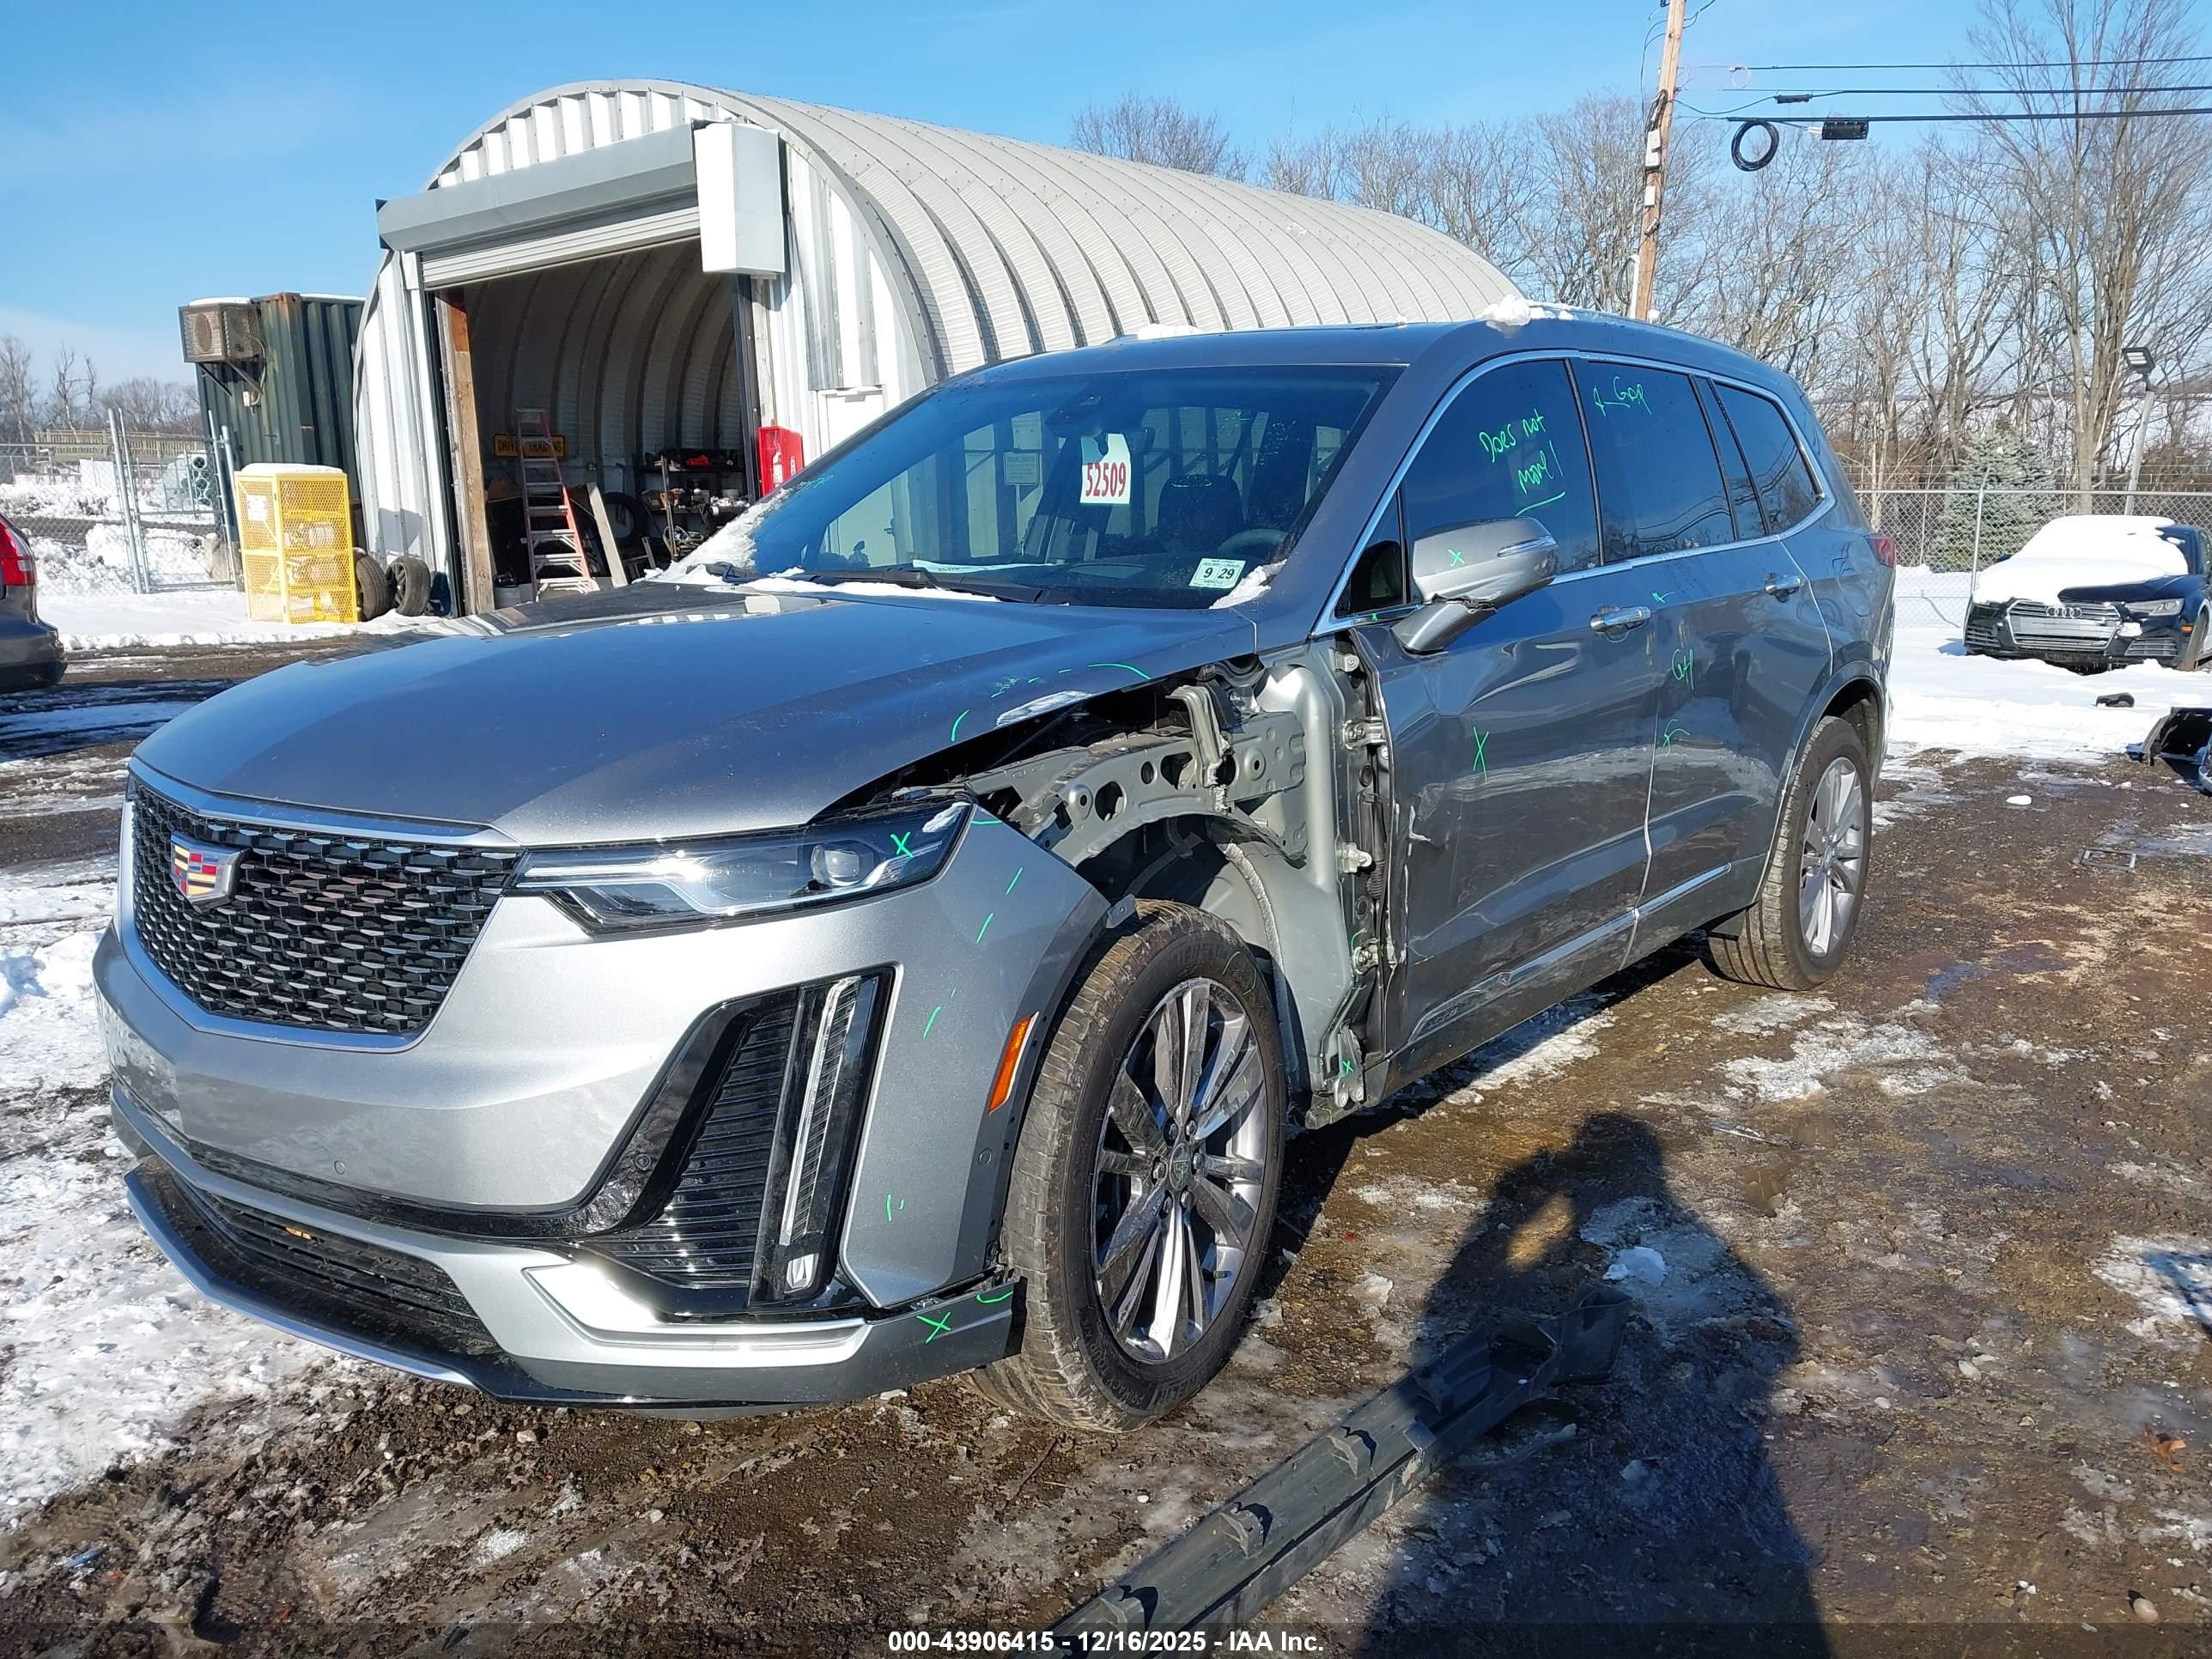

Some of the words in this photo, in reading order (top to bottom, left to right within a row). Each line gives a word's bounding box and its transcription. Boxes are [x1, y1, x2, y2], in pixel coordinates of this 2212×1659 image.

[1479, 423, 1516, 463] Does
[1522, 408, 1547, 438] not
[1085, 461, 1127, 497] 52509
[1203, 567, 1213, 578] 9
[1218, 568, 1235, 580] 29
[1107, 1376, 1146, 1405] PRIMACY
